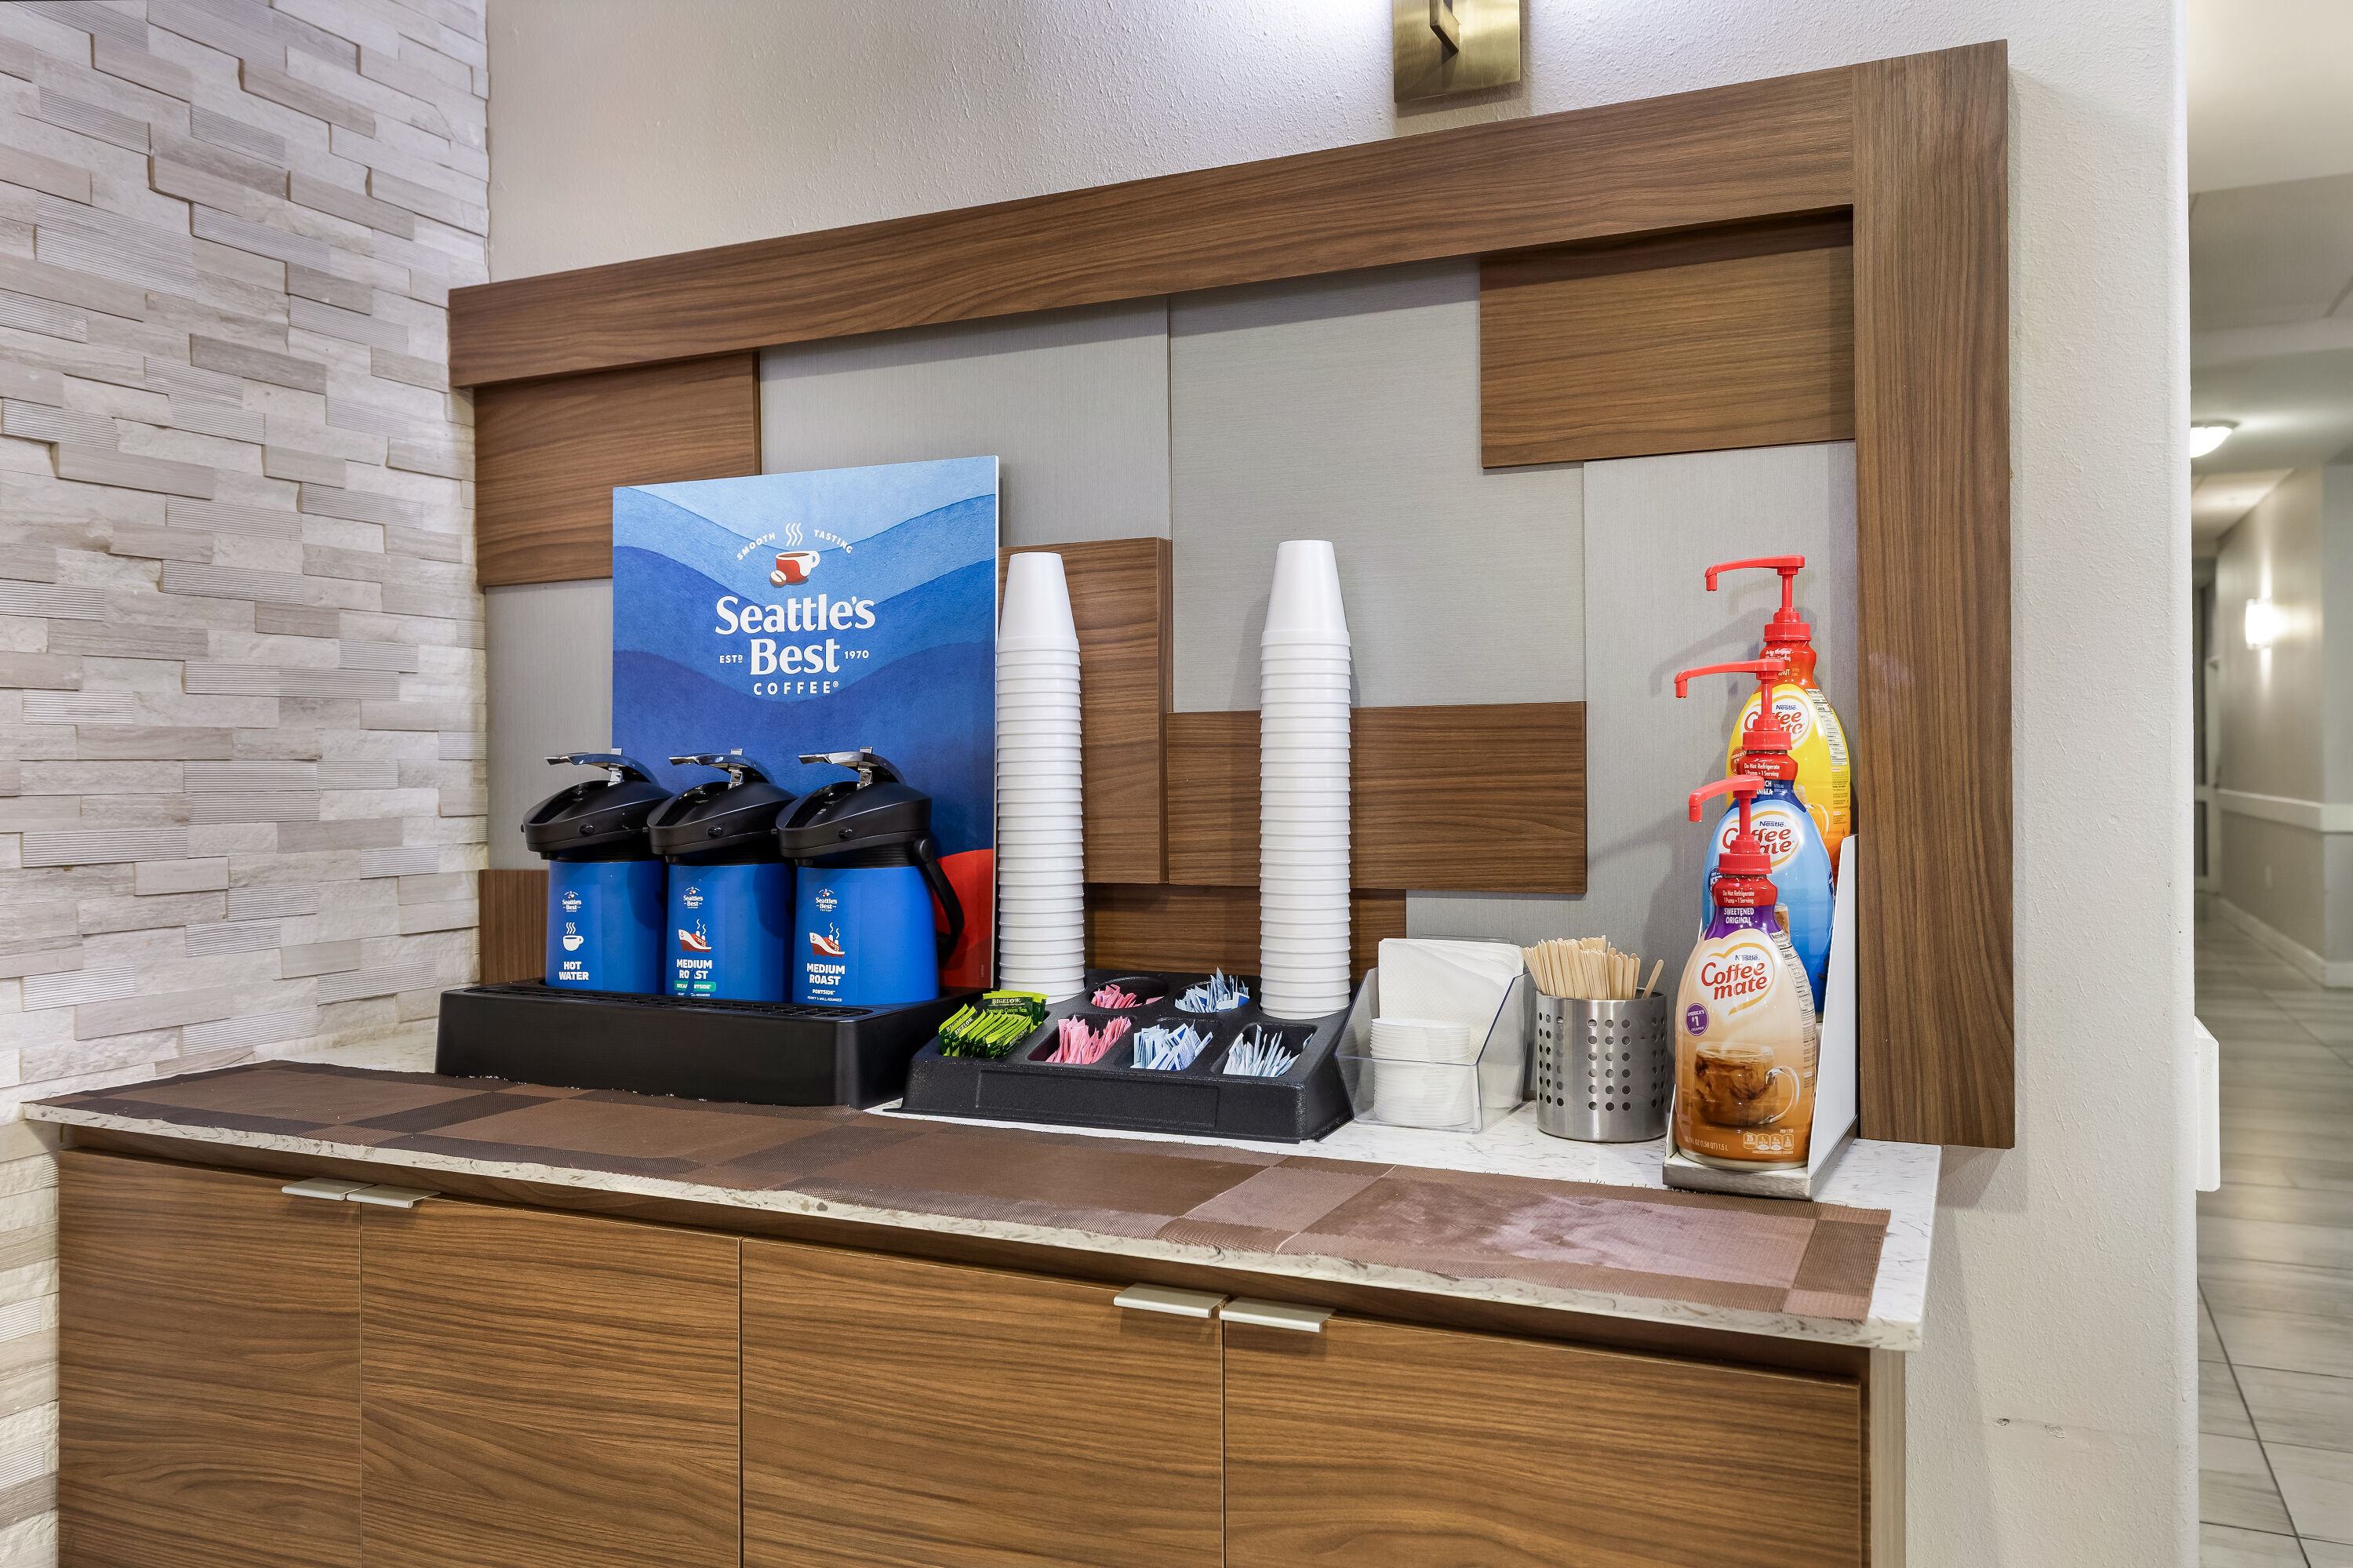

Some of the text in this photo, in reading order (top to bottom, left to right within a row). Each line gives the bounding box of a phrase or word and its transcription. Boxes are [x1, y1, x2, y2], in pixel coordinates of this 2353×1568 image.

[736, 529, 853, 561] SMOOTH TASTING
[715, 594, 875, 635] Seattle's
[750, 638, 840, 675] Best
[844, 650, 869, 660] 1970
[1757, 762, 1780, 771] Refrigerate
[1724, 908, 1754, 916] SWEETENED
[563, 961, 582, 970] HOT
[676, 959, 713, 970] MEDIUM
[806, 962, 846, 975] MEDIUM
[558, 971, 589, 980] WATER
[678, 970, 709, 980] ROST
[809, 973, 842, 986] ROAST
[1700, 962, 1766, 987] Coffee
[1714, 976, 1768, 1000] mate
